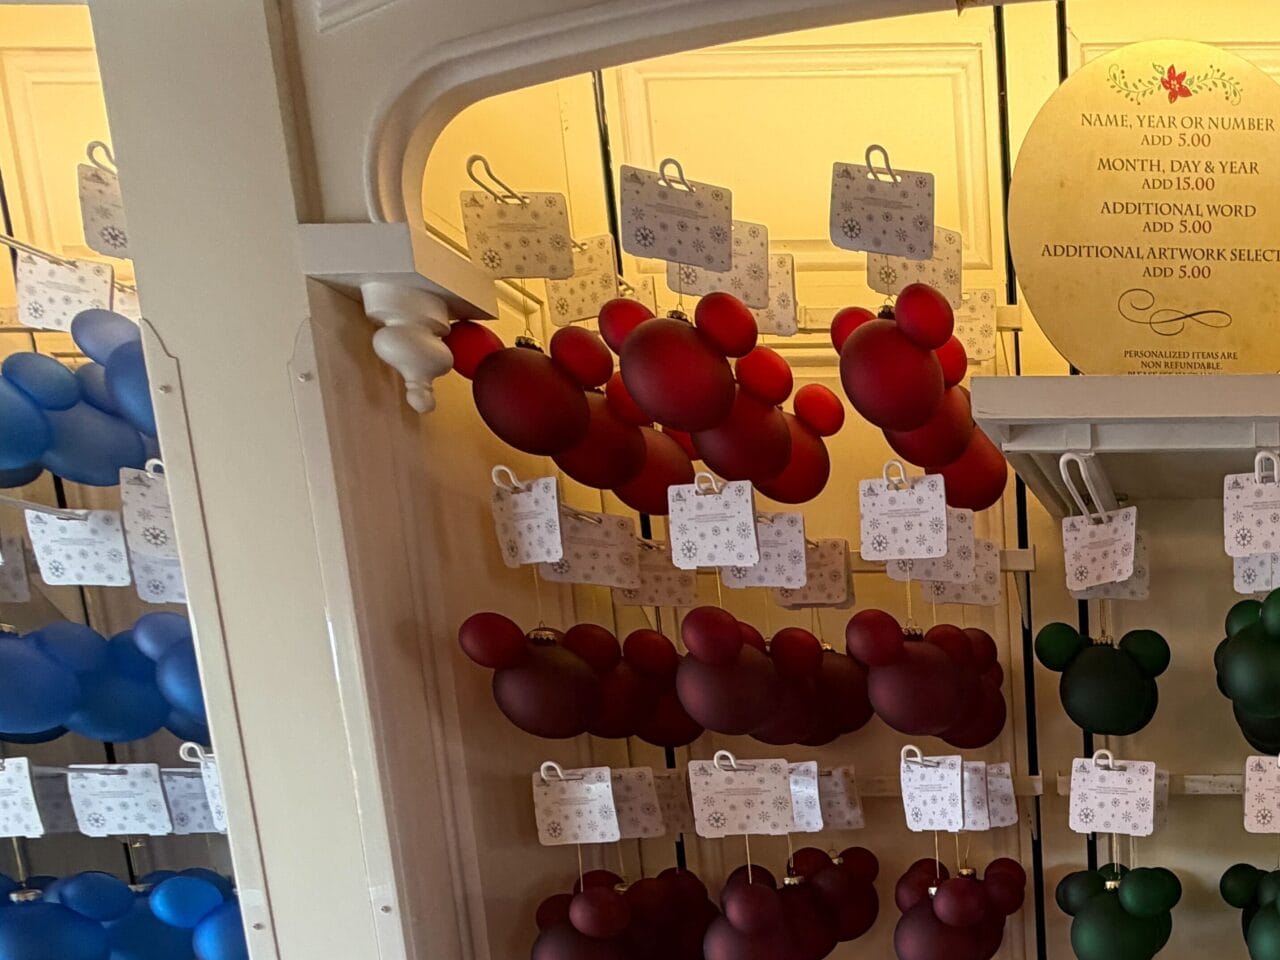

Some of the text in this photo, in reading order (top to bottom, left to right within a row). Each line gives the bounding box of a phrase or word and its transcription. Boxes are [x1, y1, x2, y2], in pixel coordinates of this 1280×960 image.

[1081, 113, 1276, 132] NAME, YEAR OR NUMBER
[1140, 133, 1211, 147] ADD 5.00
[1097, 158, 1260, 175] MONTH, DAY & YEAR
[1141, 177, 1215, 191] ADD 15.00
[1100, 201, 1257, 217] ADDITIONAL WORD
[1142, 220, 1212, 234] ADD 5.00
[1041, 244, 1145, 260] ADDITIONAL
[1146, 246, 1228, 261] ARTWORK
[1142, 265, 1212, 279] ADD 5.00
[1123, 350, 1239, 360] PERSONALIZED ITEMS ARE
[1140, 360, 1223, 370] NON REFUNDABLE.
